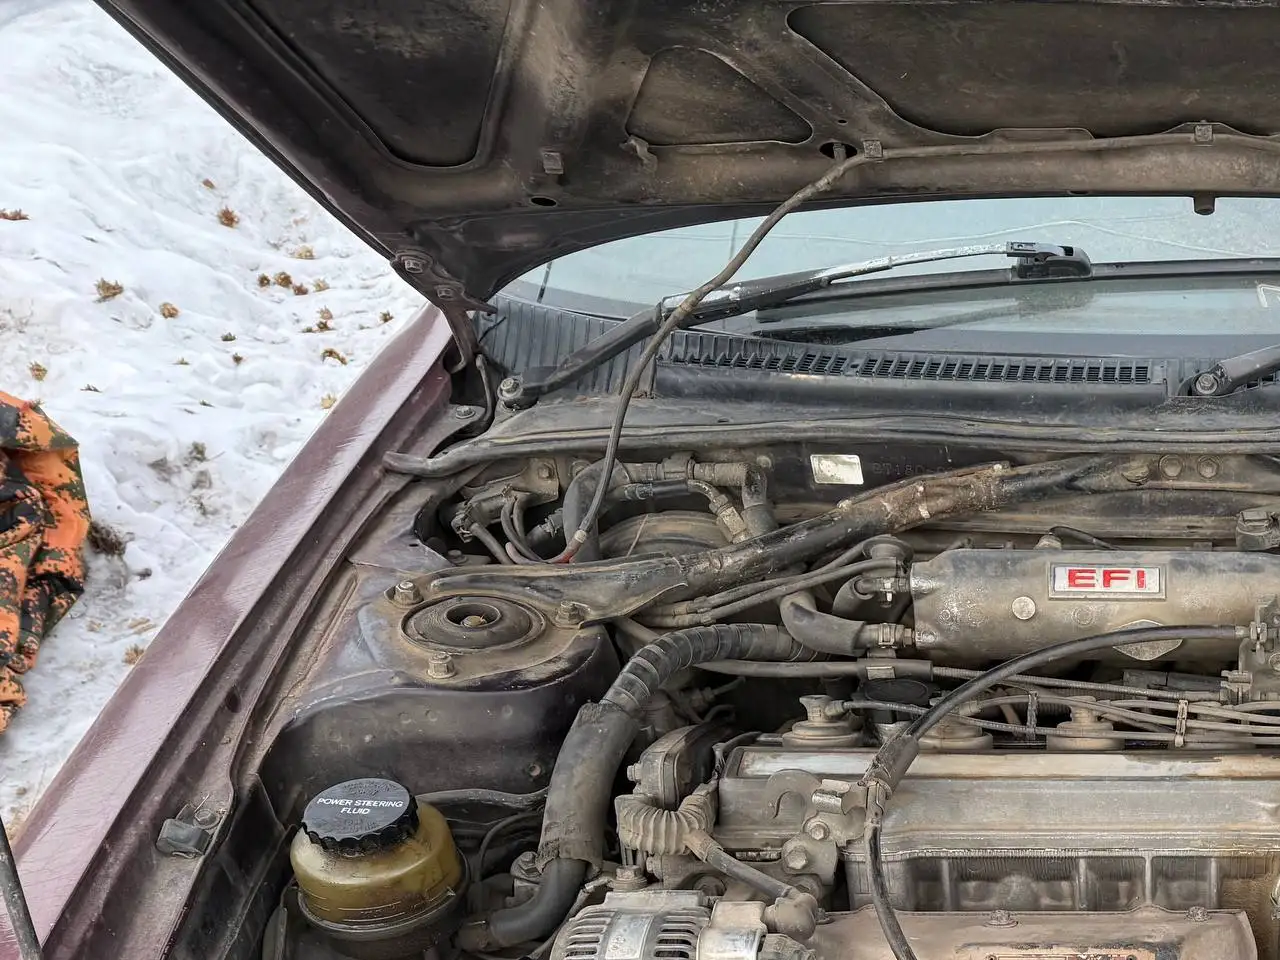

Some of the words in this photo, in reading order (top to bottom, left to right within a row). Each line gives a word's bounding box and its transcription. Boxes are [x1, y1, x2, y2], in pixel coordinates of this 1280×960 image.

[1068, 569, 1146, 588] EFI
[317, 797, 353, 806] POWER
[354, 799, 404, 808] STEERING
[340, 807, 371, 815] FLUID
